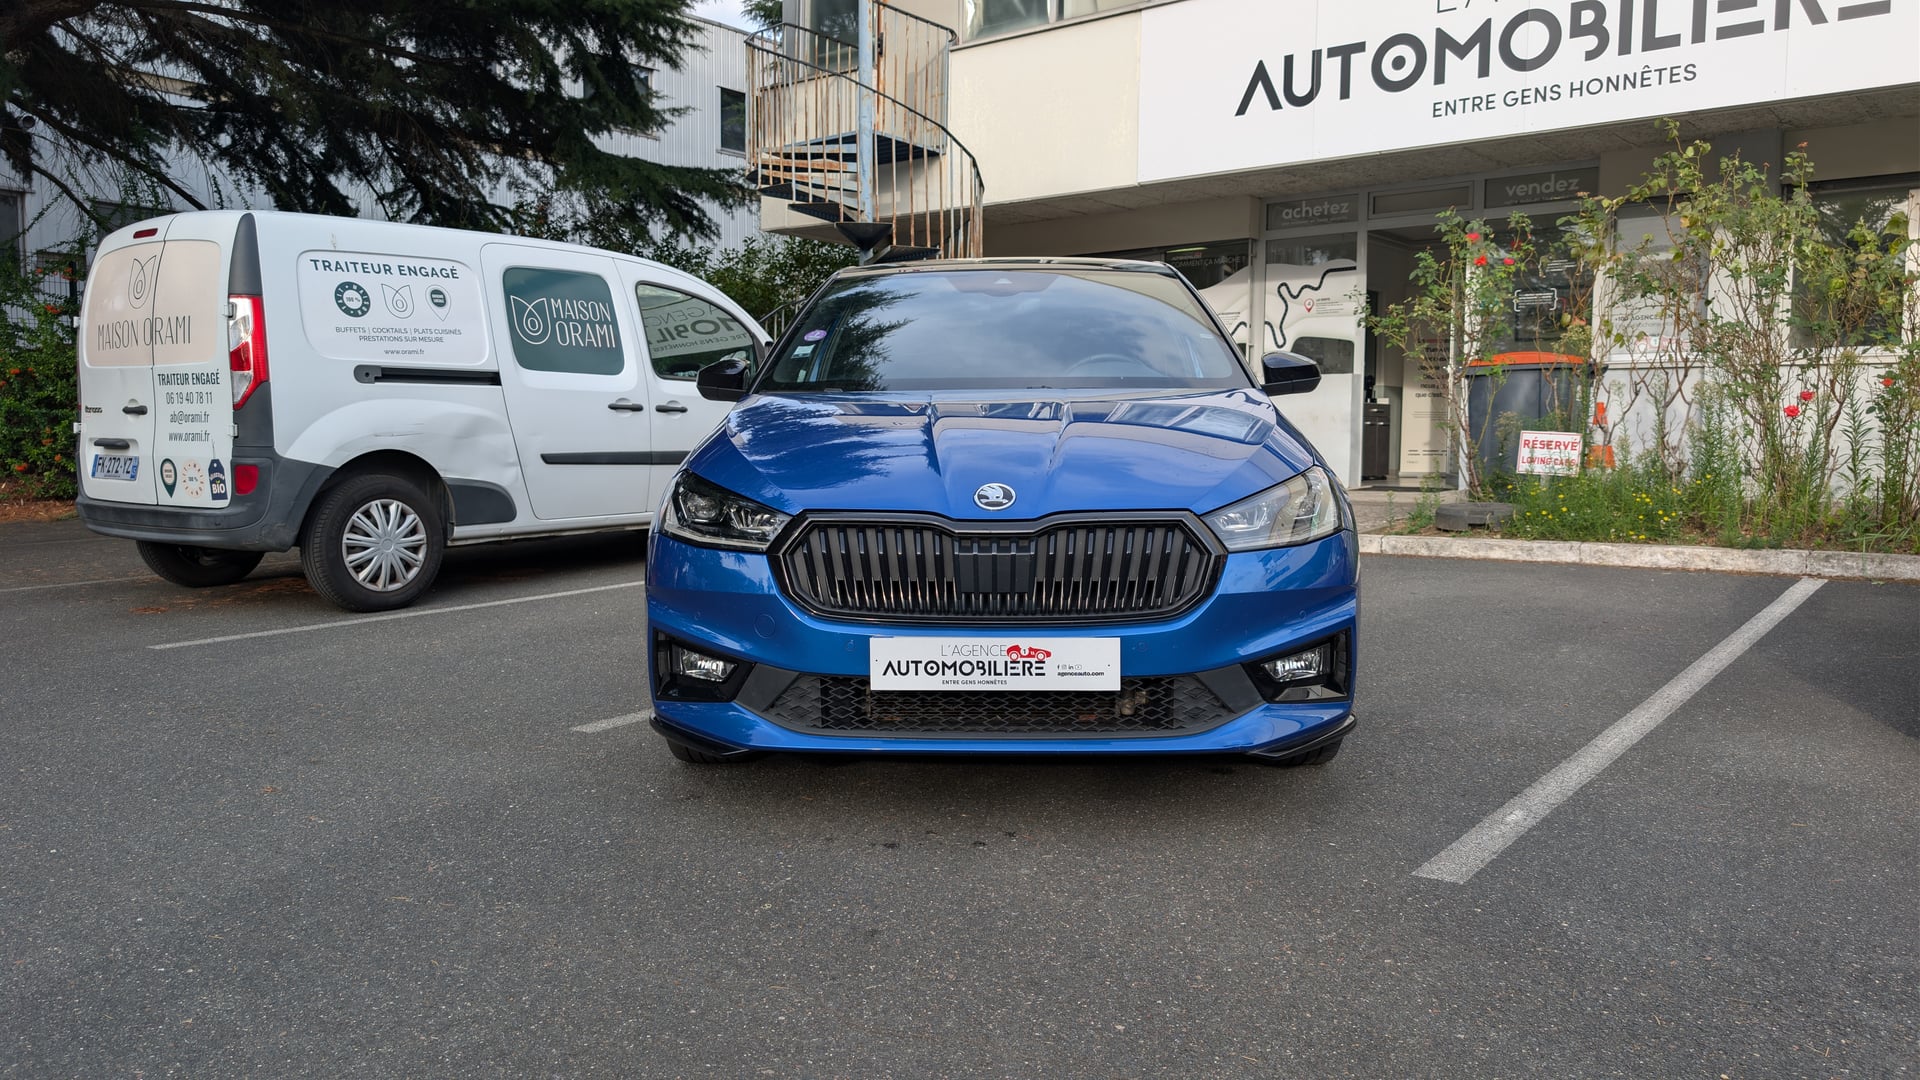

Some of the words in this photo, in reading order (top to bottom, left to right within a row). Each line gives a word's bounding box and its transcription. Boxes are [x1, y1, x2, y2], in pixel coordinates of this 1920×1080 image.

[1234, 0, 1891, 117] AUTOMOBILIE
[1432, 94, 1496, 118] ENTRE
[1502, 84, 1562, 108] GENS
[1569, 63, 1698, 98] HONNÊTES
[1505, 173, 1580, 197] vendez
[1282, 200, 1349, 219] achetez
[310, 258, 393, 276] TRAITEUR
[397, 264, 460, 280] ENGAGÉ
[550, 297, 612, 322] MAISON
[97, 319, 139, 352] MAISON
[143, 315, 191, 346] ORAMI
[335, 326, 367, 334] BUFFETS
[372, 327, 408, 335] COCKTAILS
[434, 328, 462, 336] CUISINÉS
[359, 335, 404, 343] PRESTATIONS
[555, 320, 616, 348] ORAMI
[157, 372, 190, 387] TRAITEUR
[191, 368, 220, 386] ENGAGÉ
[165, 391, 176, 405] 06
[176, 391, 184, 405] 19
[185, 391, 194, 405] 40
[195, 391, 203, 405] 78
[205, 391, 213, 405] 11
[169, 411, 210, 425] ab@orami.fr
[168, 430, 211, 442] www.orami.fr
[1523, 436, 1579, 451] RÉSERVÉ
[211, 483, 226, 494] BIO
[941, 644, 1007, 657] L'AGENCE
